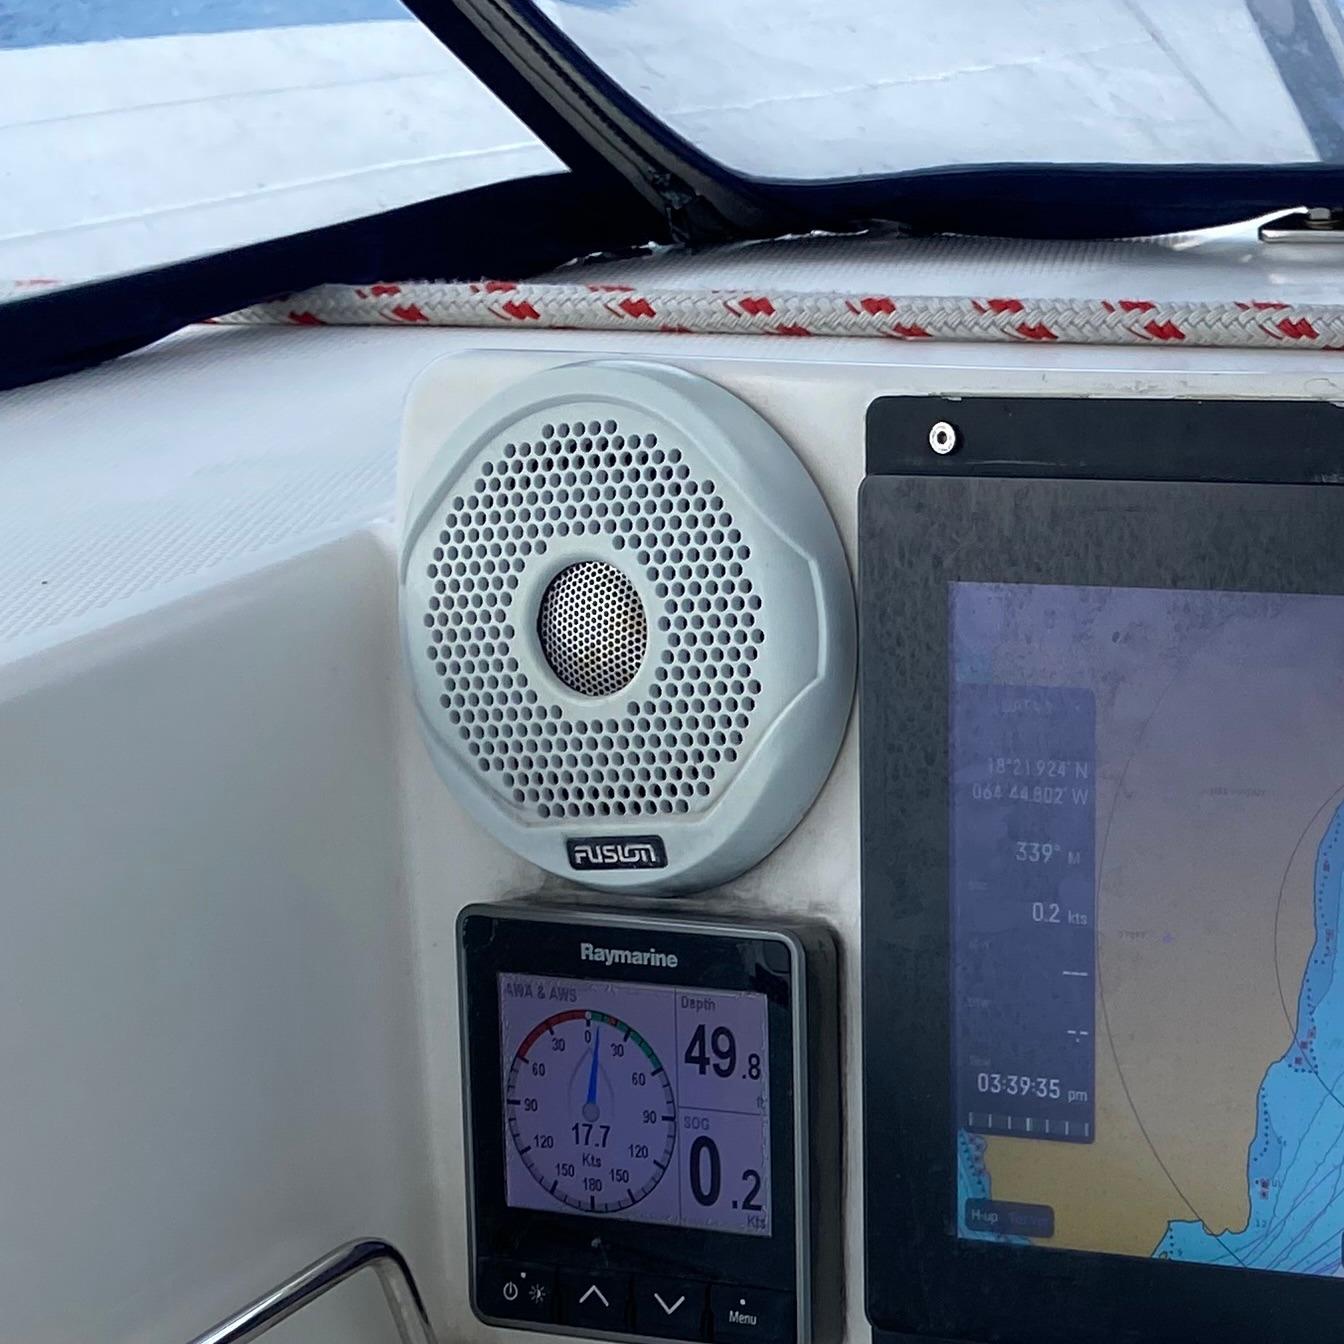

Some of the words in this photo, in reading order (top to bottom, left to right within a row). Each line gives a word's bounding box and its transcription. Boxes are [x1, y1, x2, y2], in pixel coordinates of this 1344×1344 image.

[574, 844, 656, 864] FUSION
[1032, 902, 1061, 923] 0.2
[1068, 911, 1088, 925] kts
[580, 943, 678, 968] Raymarine
[550, 985, 578, 1002] AWS
[585, 1031, 592, 1044] 0
[552, 1038, 566, 1052] 30
[611, 1043, 625, 1057] 30
[532, 1063, 546, 1077] 60
[632, 1073, 646, 1086] 60
[977, 1073, 1061, 1099] 03:39:35
[1068, 1088, 1088, 1103] pm
[524, 1098, 538, 1112] 90
[642, 1110, 657, 1124] 90
[683, 1115, 710, 1131] SOG
[534, 1135, 554, 1148] 120
[571, 1122, 611, 1148] 17.7
[628, 1144, 649, 1158] 120
[582, 1152, 601, 1167] Kts
[556, 1163, 575, 1177] 150
[609, 1169, 629, 1183] 150
[583, 1178, 602, 1192] 180
[747, 1216, 767, 1230] Kts
[728, 1310, 758, 1326] Menu
